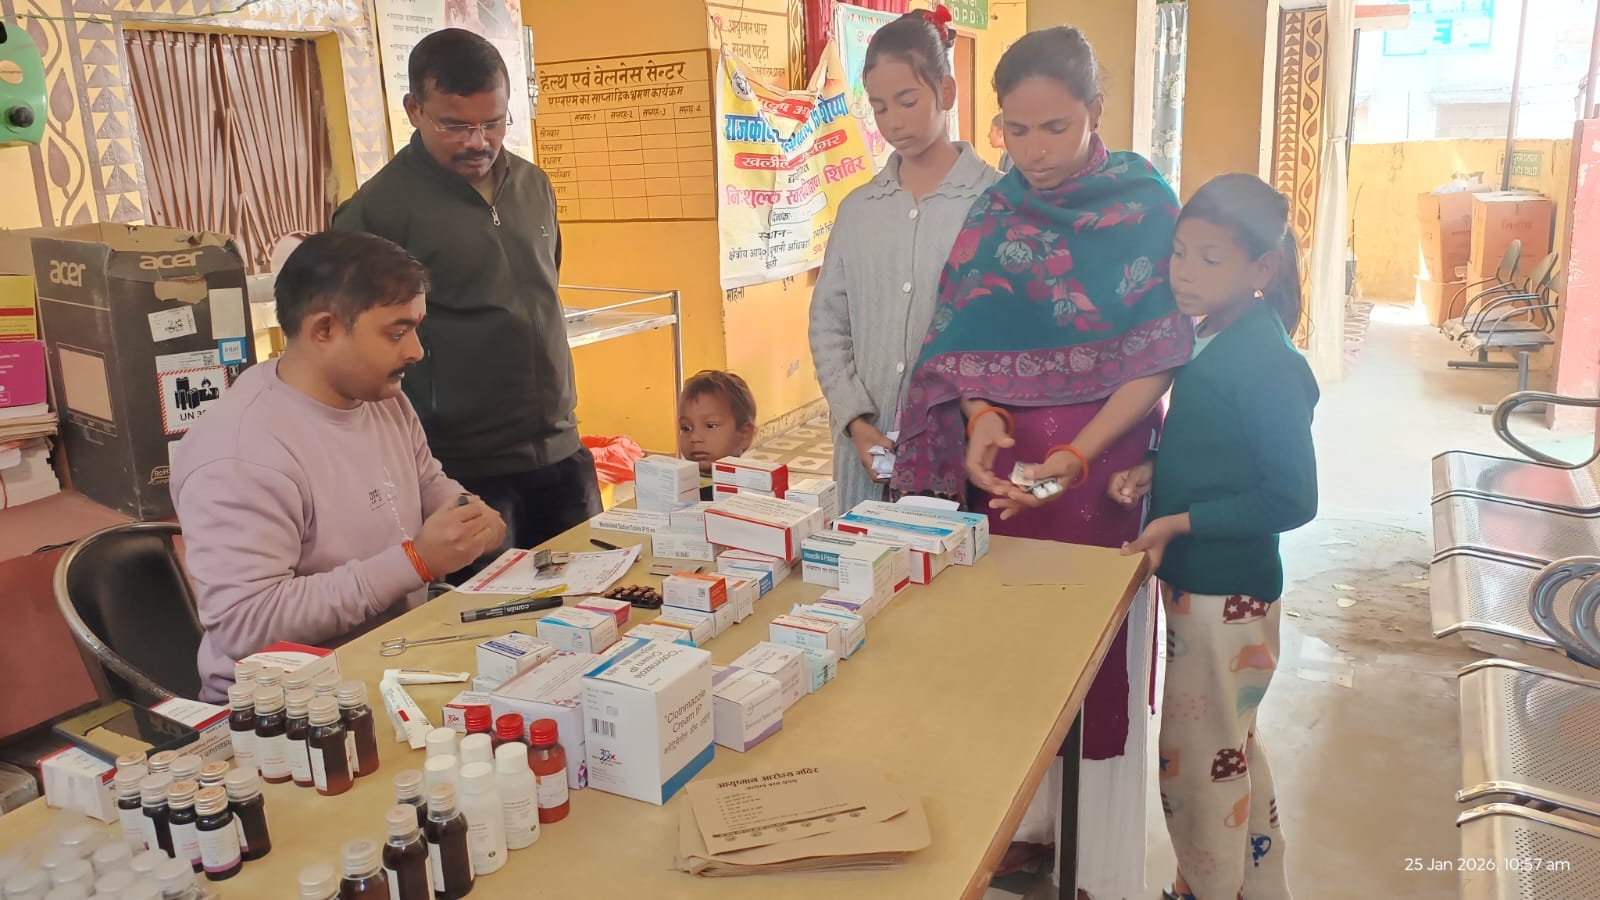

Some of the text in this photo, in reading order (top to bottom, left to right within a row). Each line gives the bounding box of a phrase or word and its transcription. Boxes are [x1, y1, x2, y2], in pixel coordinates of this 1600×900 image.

[540, 60, 688, 92] हेल्थ एवं वेलनेस सेन्टर
[651, 84, 684, 98] कार्यक्रम
[822, 156, 866, 184] शिविर
[139, 250, 204, 271] acer
[49, 259, 87, 288] acer
[224, 344, 240, 354] intel
[180, 409, 196, 422] UN
[154, 469, 170, 478] RoH
[672, 711, 695, 733] Cream
[696, 703, 703, 715] IP
